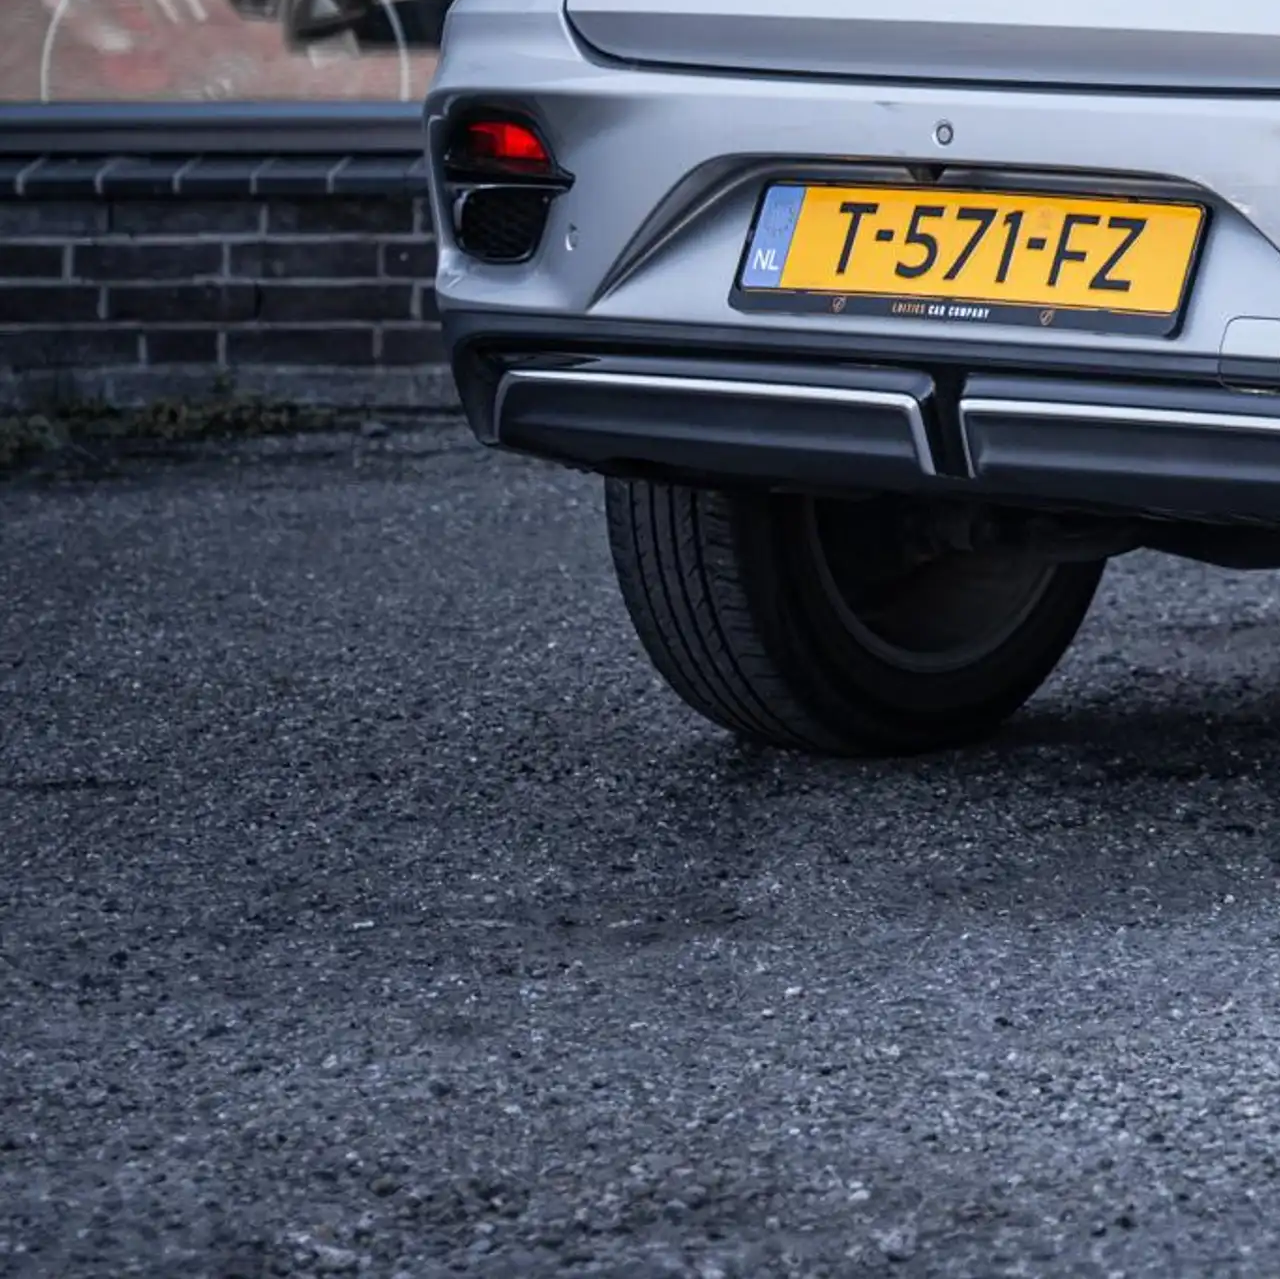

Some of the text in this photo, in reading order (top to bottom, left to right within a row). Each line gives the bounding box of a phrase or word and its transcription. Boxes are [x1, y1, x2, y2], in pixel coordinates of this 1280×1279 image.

[752, 247, 779, 271] NL
[836, 201, 1149, 293] T-571-FZ
[928, 304, 946, 317] CAR
[948, 306, 990, 319] COMPANY
